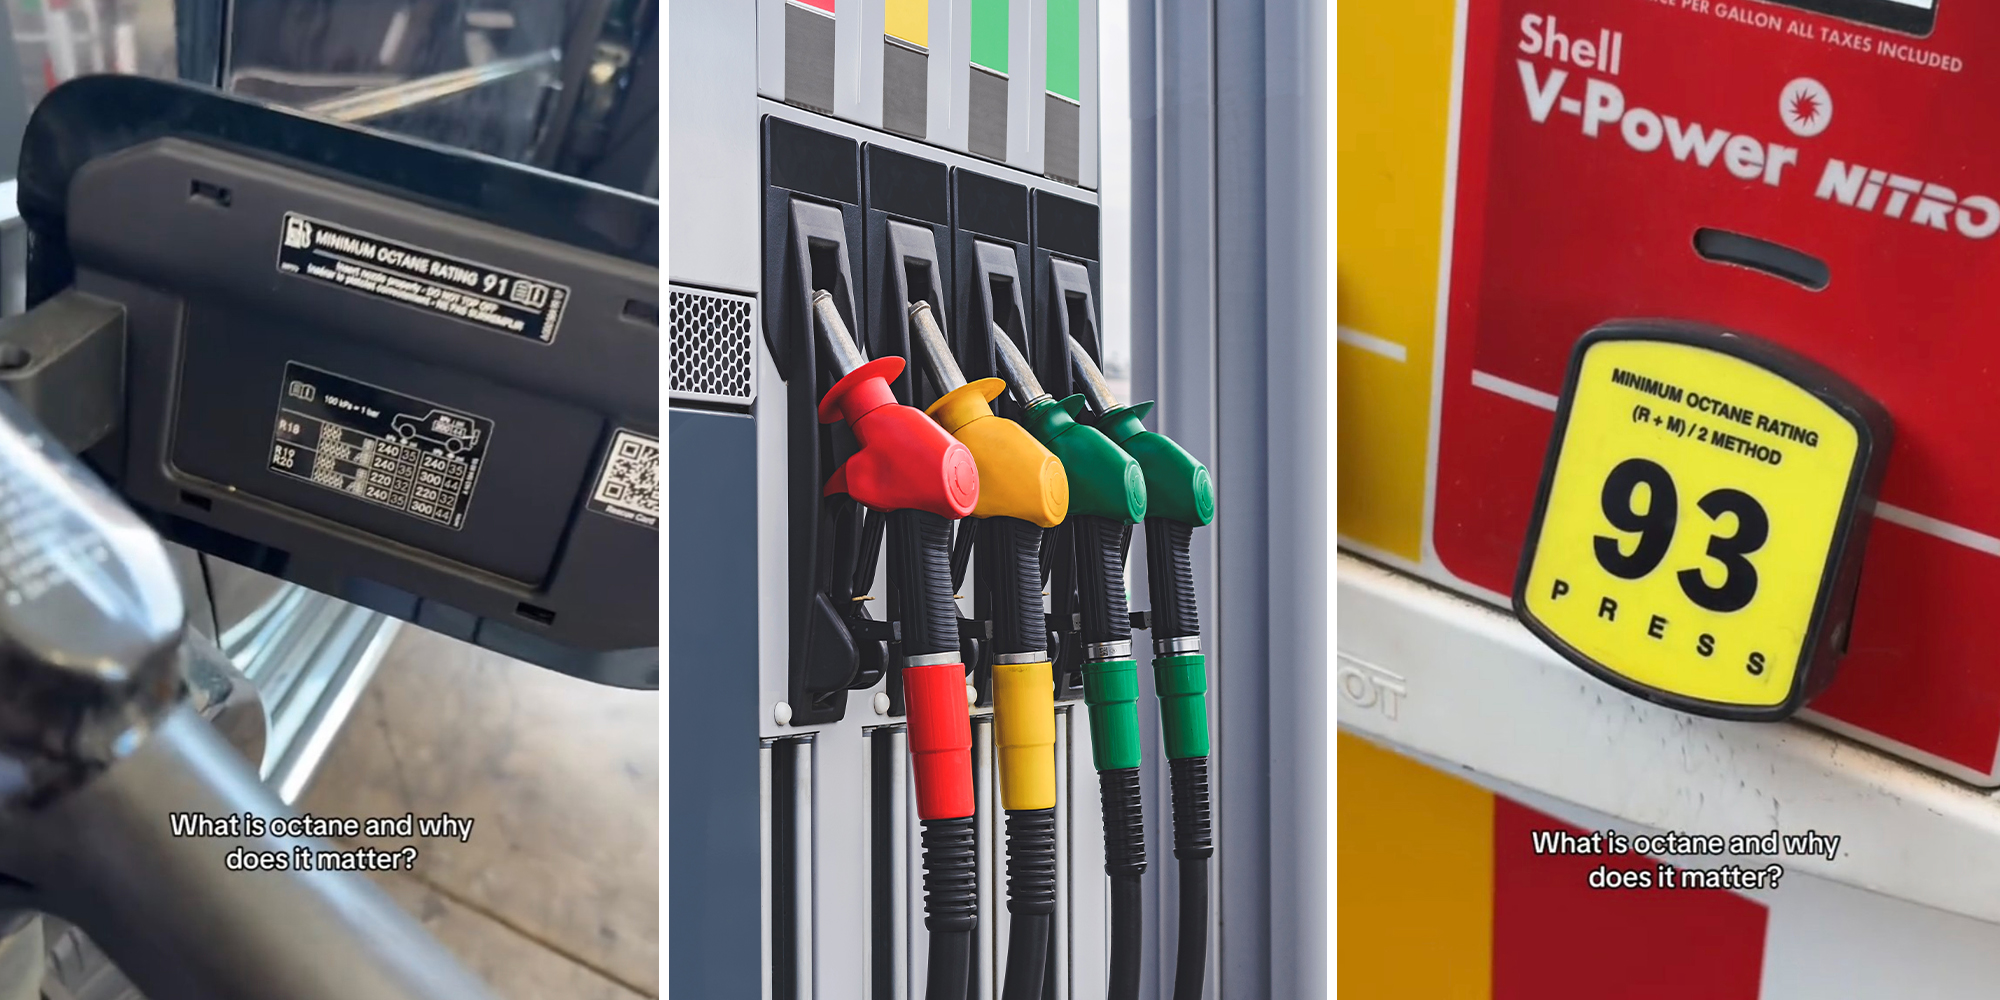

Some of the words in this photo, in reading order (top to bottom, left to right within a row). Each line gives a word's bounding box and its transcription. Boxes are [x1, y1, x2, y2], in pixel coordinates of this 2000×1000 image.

[1518, 13, 1622, 75] Shell
[1682, 0, 1709, 14] PER
[1715, 3, 1782, 32] GALLON
[1786, 20, 1814, 39] ALL
[1820, 27, 1872, 52] TAXES
[1877, 40, 1963, 73] INCLUDED
[1516, 58, 1798, 187] V-Power
[1814, 158, 2000, 239] NITRO
[315, 230, 377, 259] MINIMUM
[377, 247, 430, 273] OCTANE
[429, 262, 478, 287] RATING
[483, 273, 509, 296] 91
[1611, 368, 1684, 403] MINIMUM
[1686, 392, 1754, 426] OCTANE
[1756, 414, 1819, 448] RATING
[279, 419, 300, 435] R18
[273, 455, 294, 468] R20
[275, 445, 296, 458] R19
[377, 442, 399, 457] 240
[402, 450, 417, 462] 35
[423, 456, 446, 471] 240
[448, 464, 463, 476] 35
[1710, 430, 1783, 466] METHOD
[370, 472, 392, 486] 220
[394, 480, 409, 492] 32
[415, 486, 437, 501] 220
[440, 494, 455, 506] 32
[373, 457, 395, 472] 240
[398, 465, 412, 477] 35
[420, 471, 441, 486] 300
[444, 480, 459, 491] 44
[366, 486, 388, 501] 240
[390, 495, 404, 506] 35
[411, 501, 433, 515] 300
[435, 509, 449, 520] 44
[1593, 457, 1770, 613] 93
